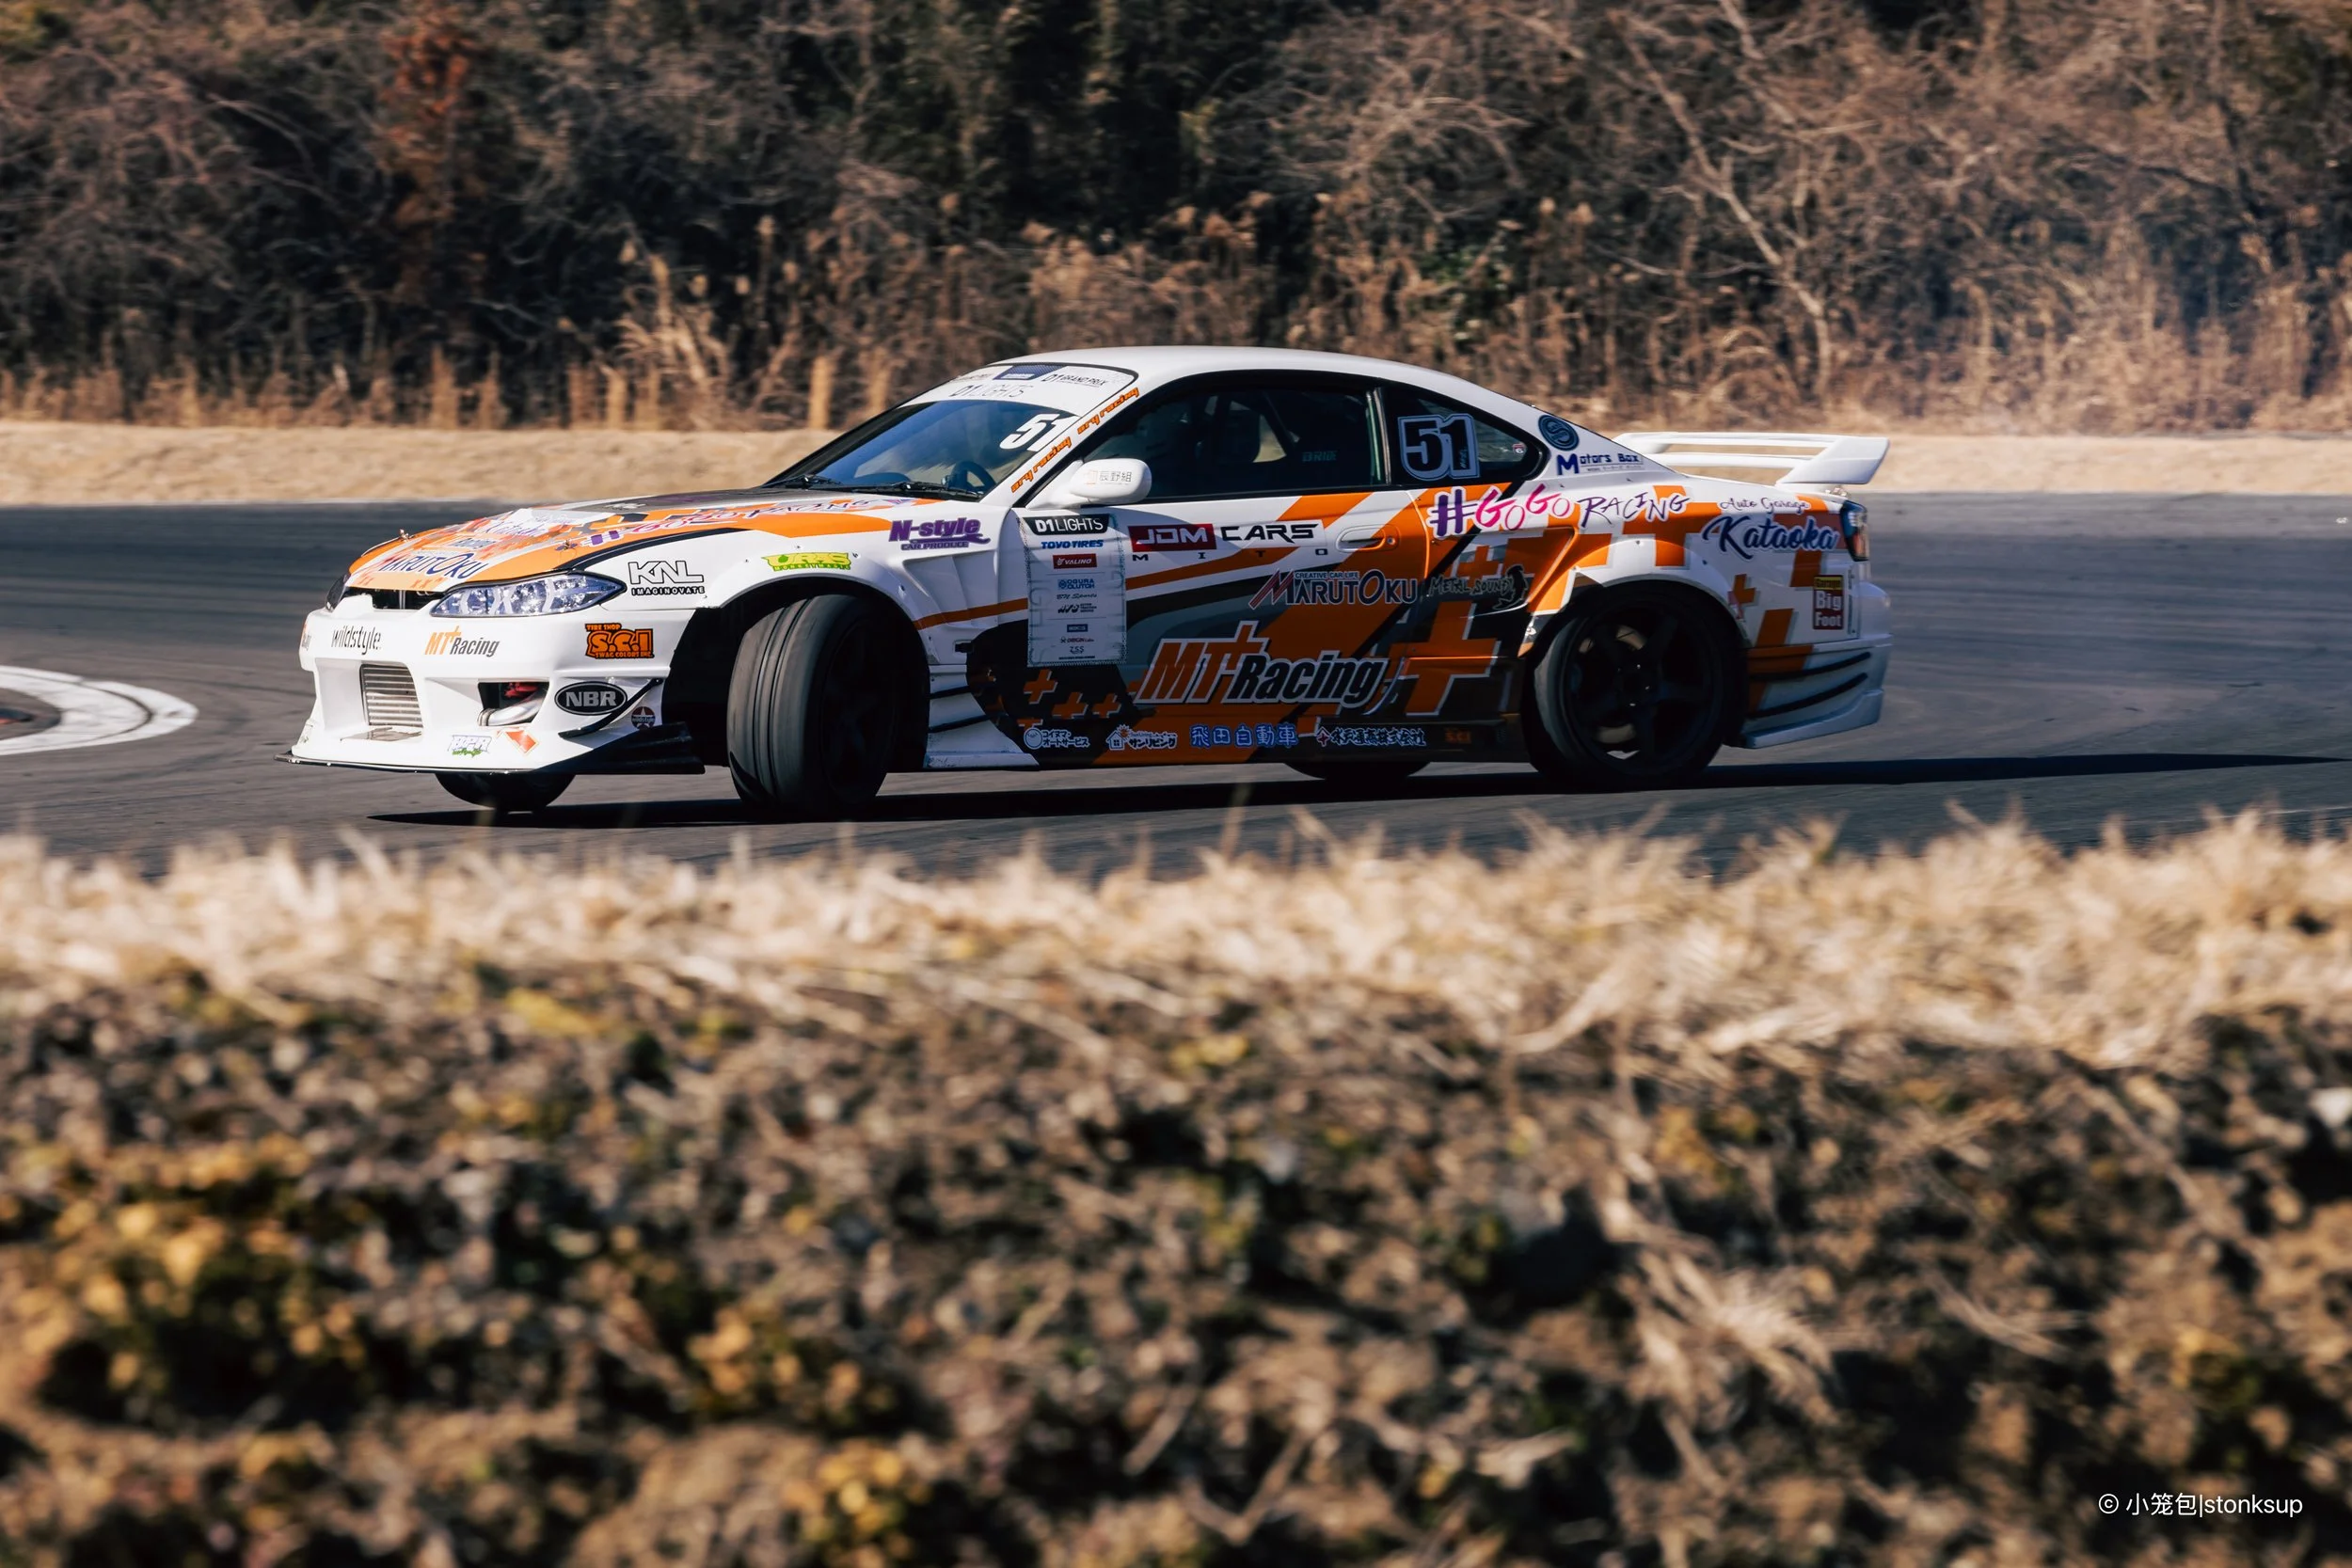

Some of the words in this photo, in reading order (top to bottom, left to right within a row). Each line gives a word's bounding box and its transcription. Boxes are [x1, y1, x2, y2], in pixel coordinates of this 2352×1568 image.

[999, 414, 1080, 451] 51
[1402, 416, 1476, 478] 51
[1577, 491, 1691, 529] RACING
[1720, 497, 1757, 510] Auto
[1760, 497, 1809, 515] Garage
[889, 517, 982, 543] N-style
[1136, 528, 1209, 545] JDM
[1220, 523, 1320, 545] CARS
[1701, 515, 1840, 560] Kataoka
[900, 543, 922, 551] CAR
[923, 541, 969, 550] PRODUCE
[1041, 541, 1071, 549] TOYO
[1072, 539, 1104, 548] TIRES
[628, 560, 705, 584] KNL
[1295, 571, 1327, 579] CREATIVE
[631, 586, 706, 596] IMAGINOVATE
[1816, 590, 1842, 611] Big
[1815, 611, 1842, 627] Foot
[330, 625, 382, 656] wildstyle
[565, 690, 617, 707] NBR
[1042, 737, 1089, 747] オートサービス
[1128, 737, 1176, 748] サンリビング
[1191, 724, 1297, 748] 飛田自動車
